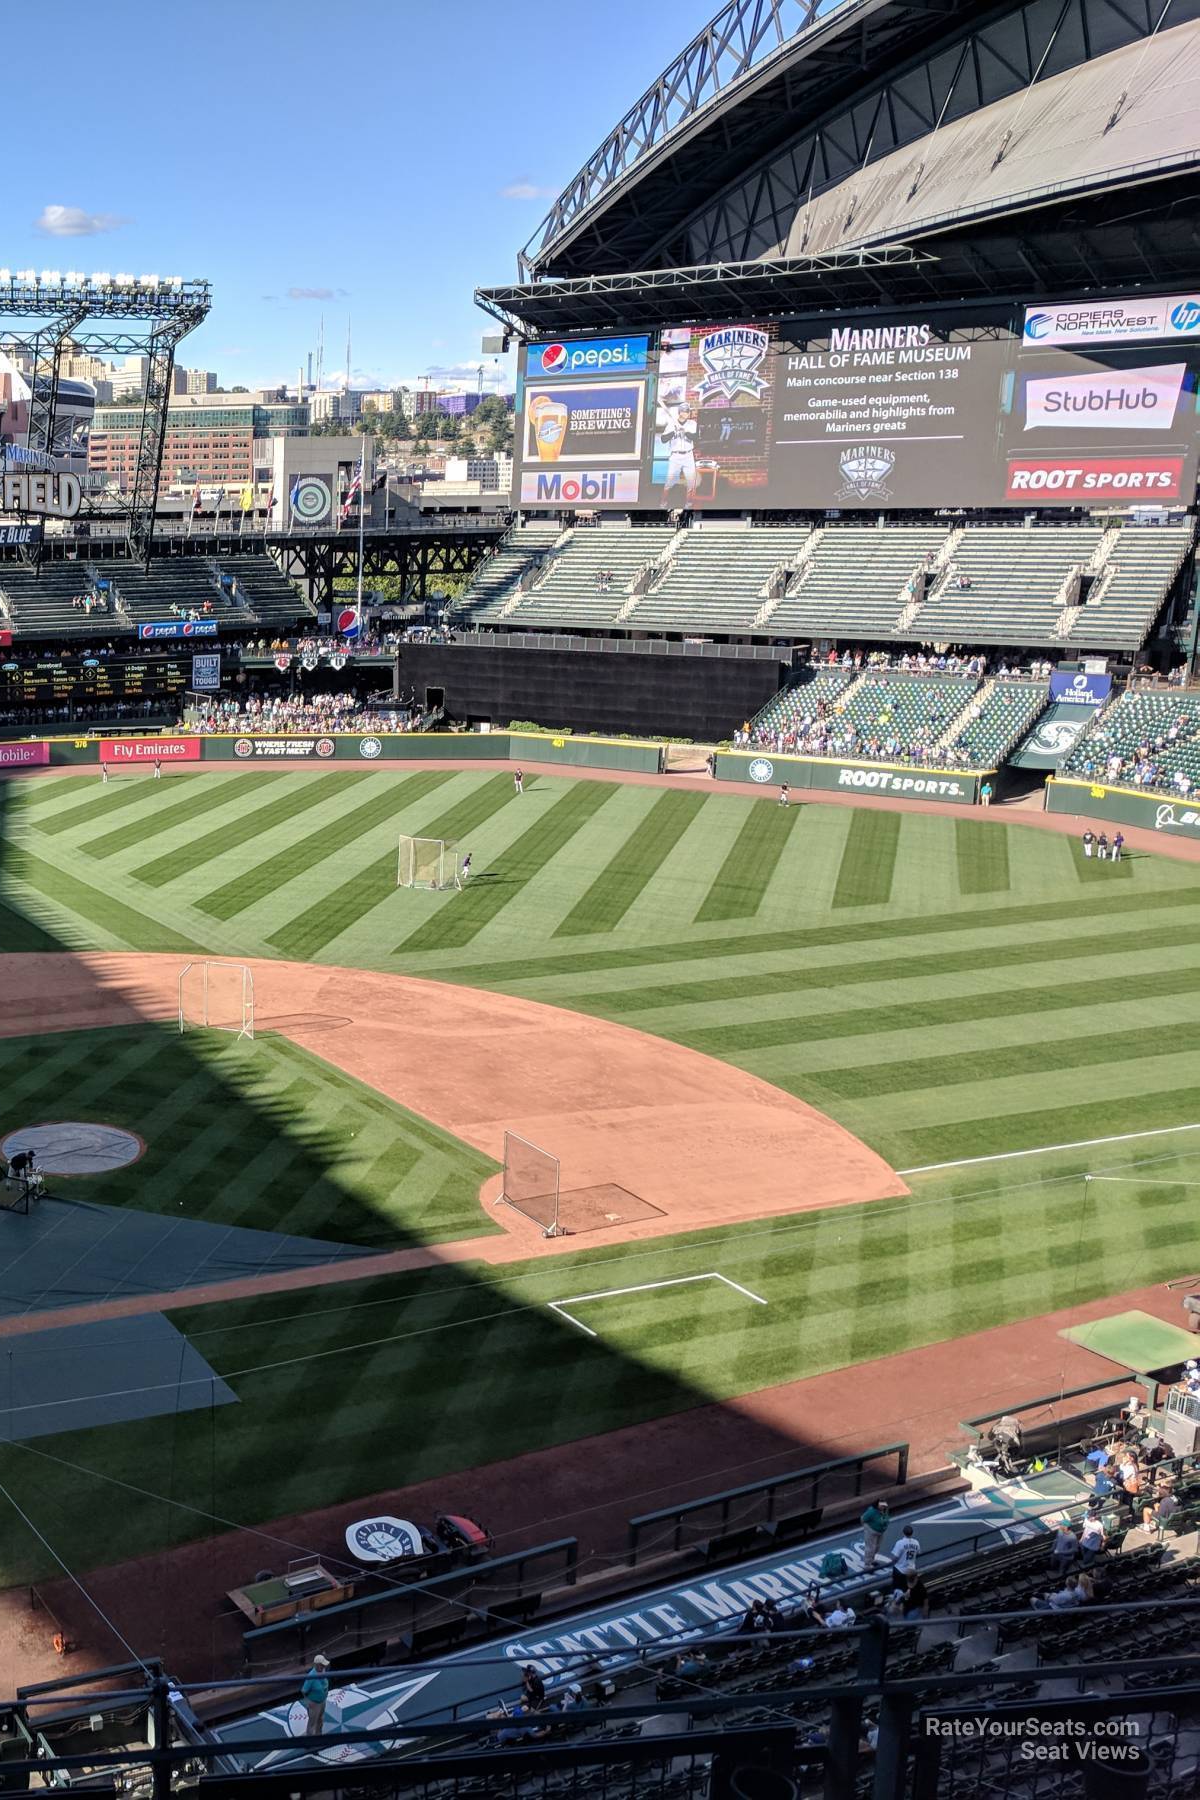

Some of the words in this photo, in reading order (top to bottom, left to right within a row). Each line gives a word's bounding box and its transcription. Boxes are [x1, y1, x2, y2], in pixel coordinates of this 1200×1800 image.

[1055, 316, 1157, 331] NORTHWEST
[1056, 309, 1124, 323] COPIERS
[1175, 302, 1200, 330] hp
[704, 330, 767, 349] MARINERS
[830, 324, 930, 353] MARINERS
[572, 343, 629, 369] pepsi
[788, 355, 826, 370] HALL
[829, 353, 850, 368] OF
[853, 350, 895, 366] FAME
[898, 346, 972, 363] MUSEUM
[710, 373, 726, 381] HALL
[736, 371, 752, 379] FAME
[786, 377, 812, 387] Main
[813, 376, 867, 386] concourse
[868, 375, 893, 383] near
[895, 370, 936, 382] Section
[938, 369, 959, 379] 138
[807, 396, 867, 408] Game-used
[868, 393, 931, 406] equipment,
[1043, 388, 1158, 412] StubHub
[571, 408, 631, 421] SOMETHING'S
[783, 411, 848, 421] memorabilia
[849, 408, 870, 419] and
[872, 405, 926, 419] highlights
[928, 404, 956, 415] from
[569, 418, 632, 431] BREWING
[825, 420, 871, 432] Mariners
[873, 421, 907, 433] greats
[5, 443, 56, 470] MARINERS
[840, 446, 896, 464] MARINERS
[536, 472, 617, 501] Mobil
[1011, 470, 1083, 489] ROOT
[1082, 471, 1173, 488] SPORTS
[3, 472, 81, 517] FIELD
[6, 526, 32, 542] BLUE
[155, 626, 176, 636] pepsi
[195, 624, 217, 634] pepsi
[195, 659, 218, 668] BUILT
[305, 659, 316, 667] 24
[195, 677, 218, 685] TOUGH
[1056, 694, 1084, 703] America
[1065, 688, 1093, 696] Holland
[114, 744, 134, 756] Fly
[136, 743, 185, 754] Emirates
[838, 769, 893, 788] ROOT
[891, 777, 960, 795] SPORTS
[906, 1551, 915, 1560] 15
[507, 1602, 696, 1672] SEATTLE
